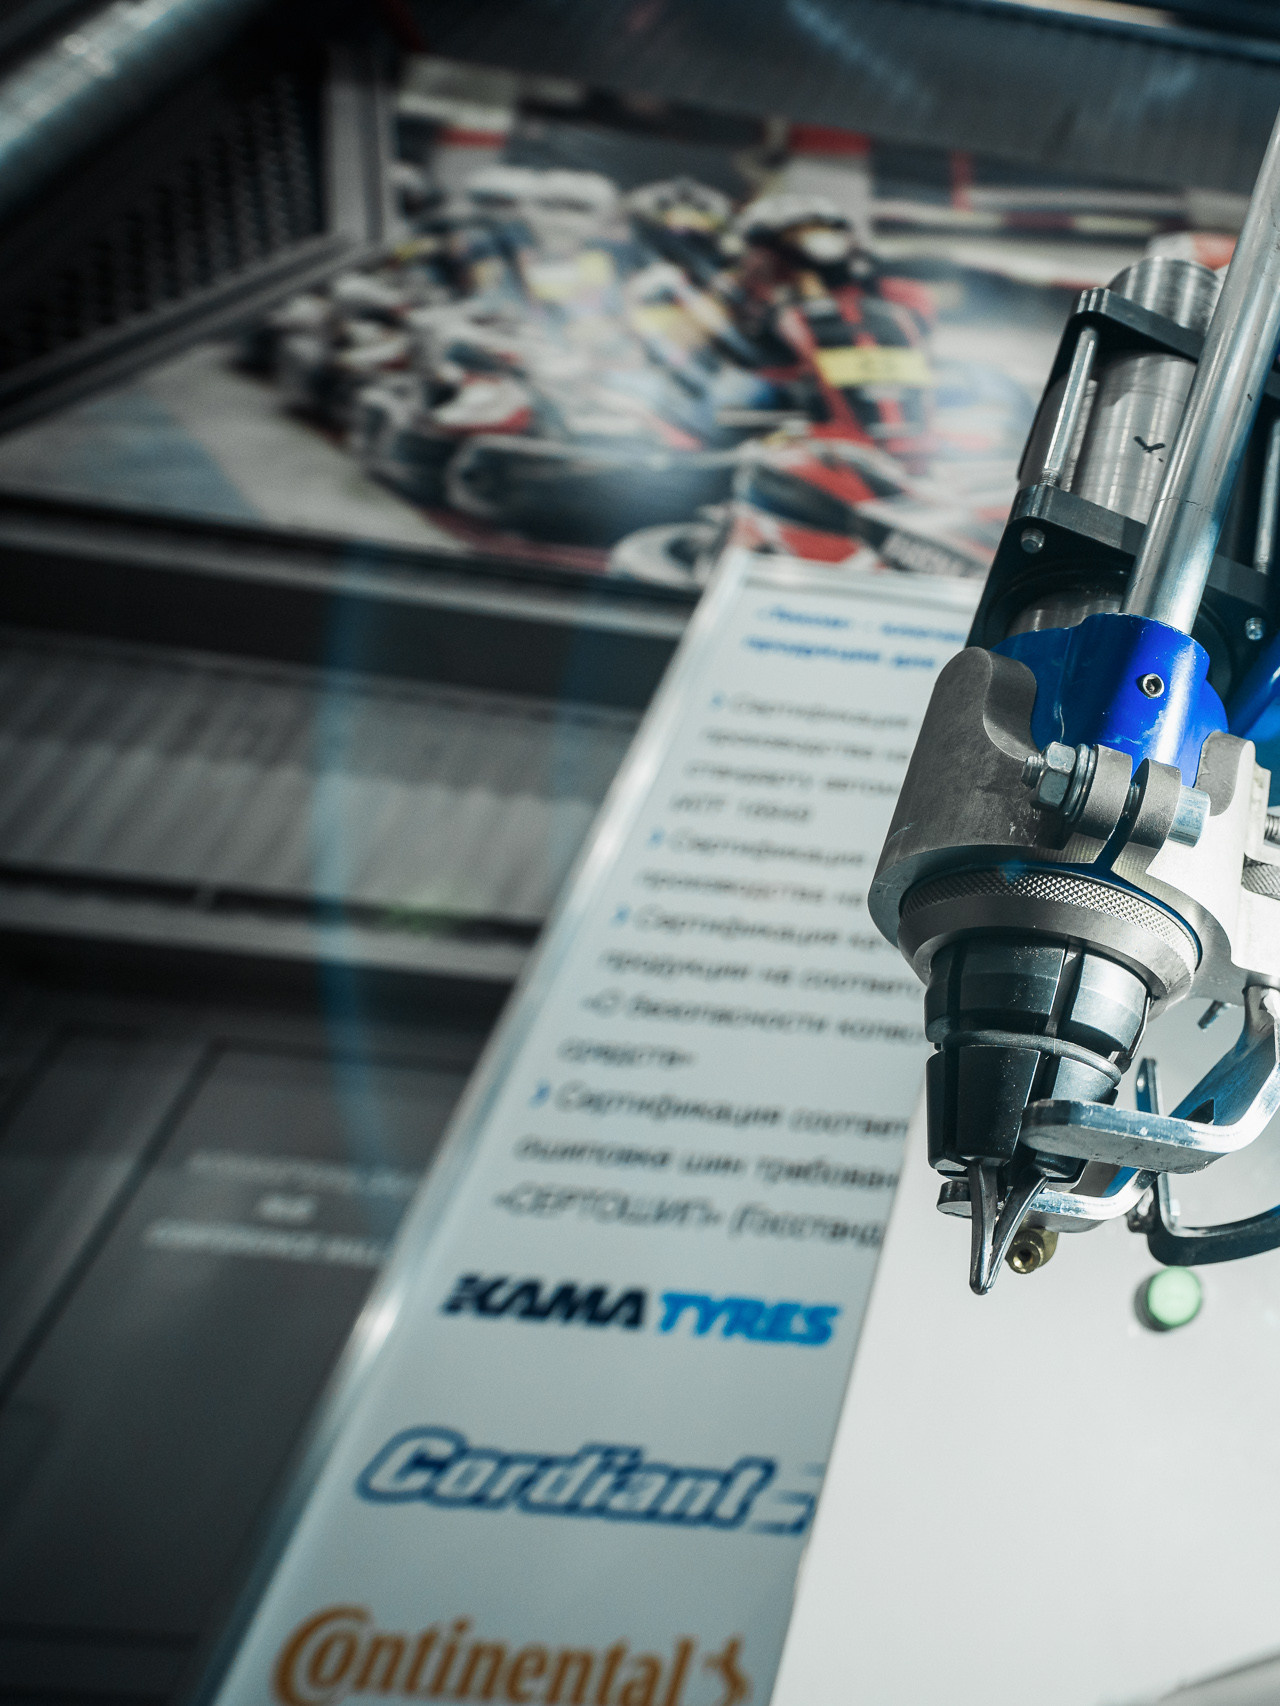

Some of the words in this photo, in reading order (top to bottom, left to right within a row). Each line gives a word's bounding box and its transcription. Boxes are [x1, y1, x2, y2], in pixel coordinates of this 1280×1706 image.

[441, 1272, 651, 1331] KAMA
[657, 1290, 843, 1347] TYRES
[354, 1424, 779, 1531] Cordiant
[270, 1603, 697, 1706] Continental
